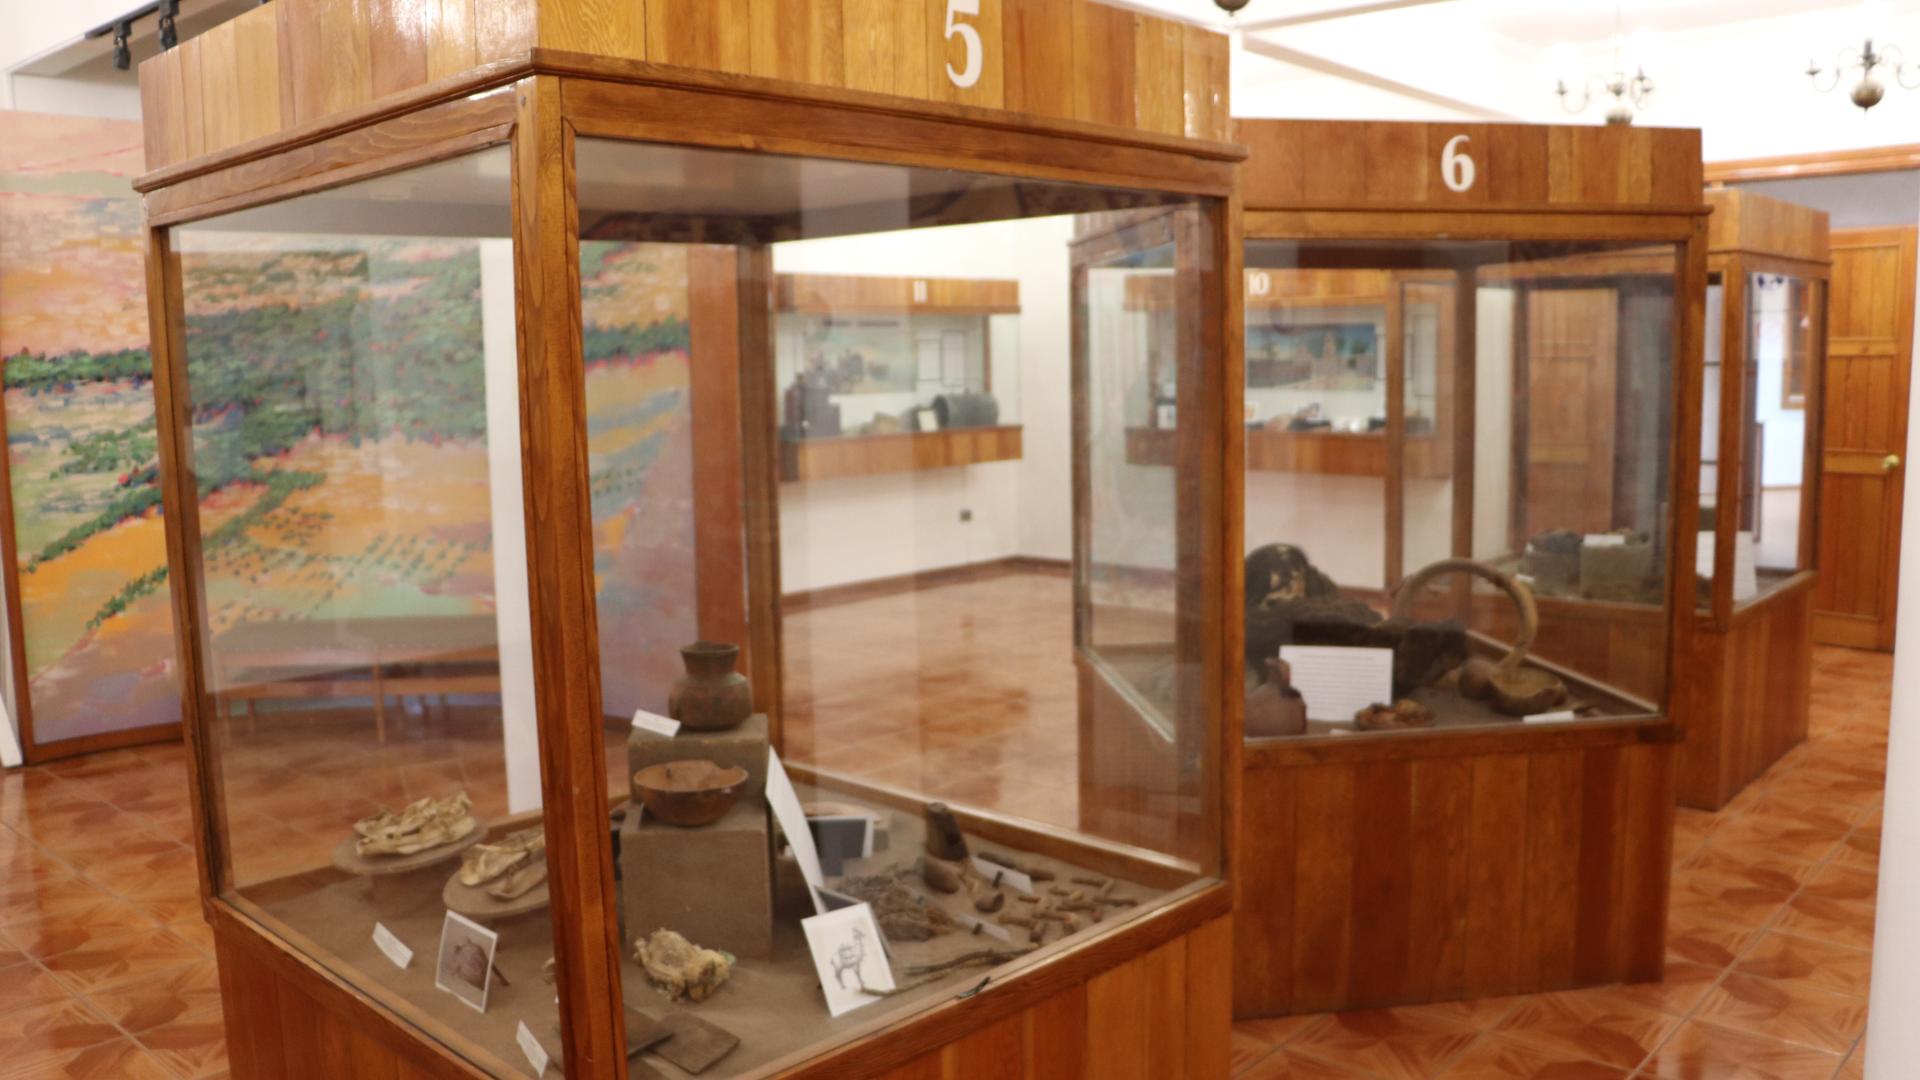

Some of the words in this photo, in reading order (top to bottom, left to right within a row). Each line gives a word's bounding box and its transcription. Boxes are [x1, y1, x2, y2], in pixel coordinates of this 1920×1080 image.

[945, 0, 983, 88] 5
[1441, 134, 1476, 192] 6
[1249, 271, 1270, 296] 10
